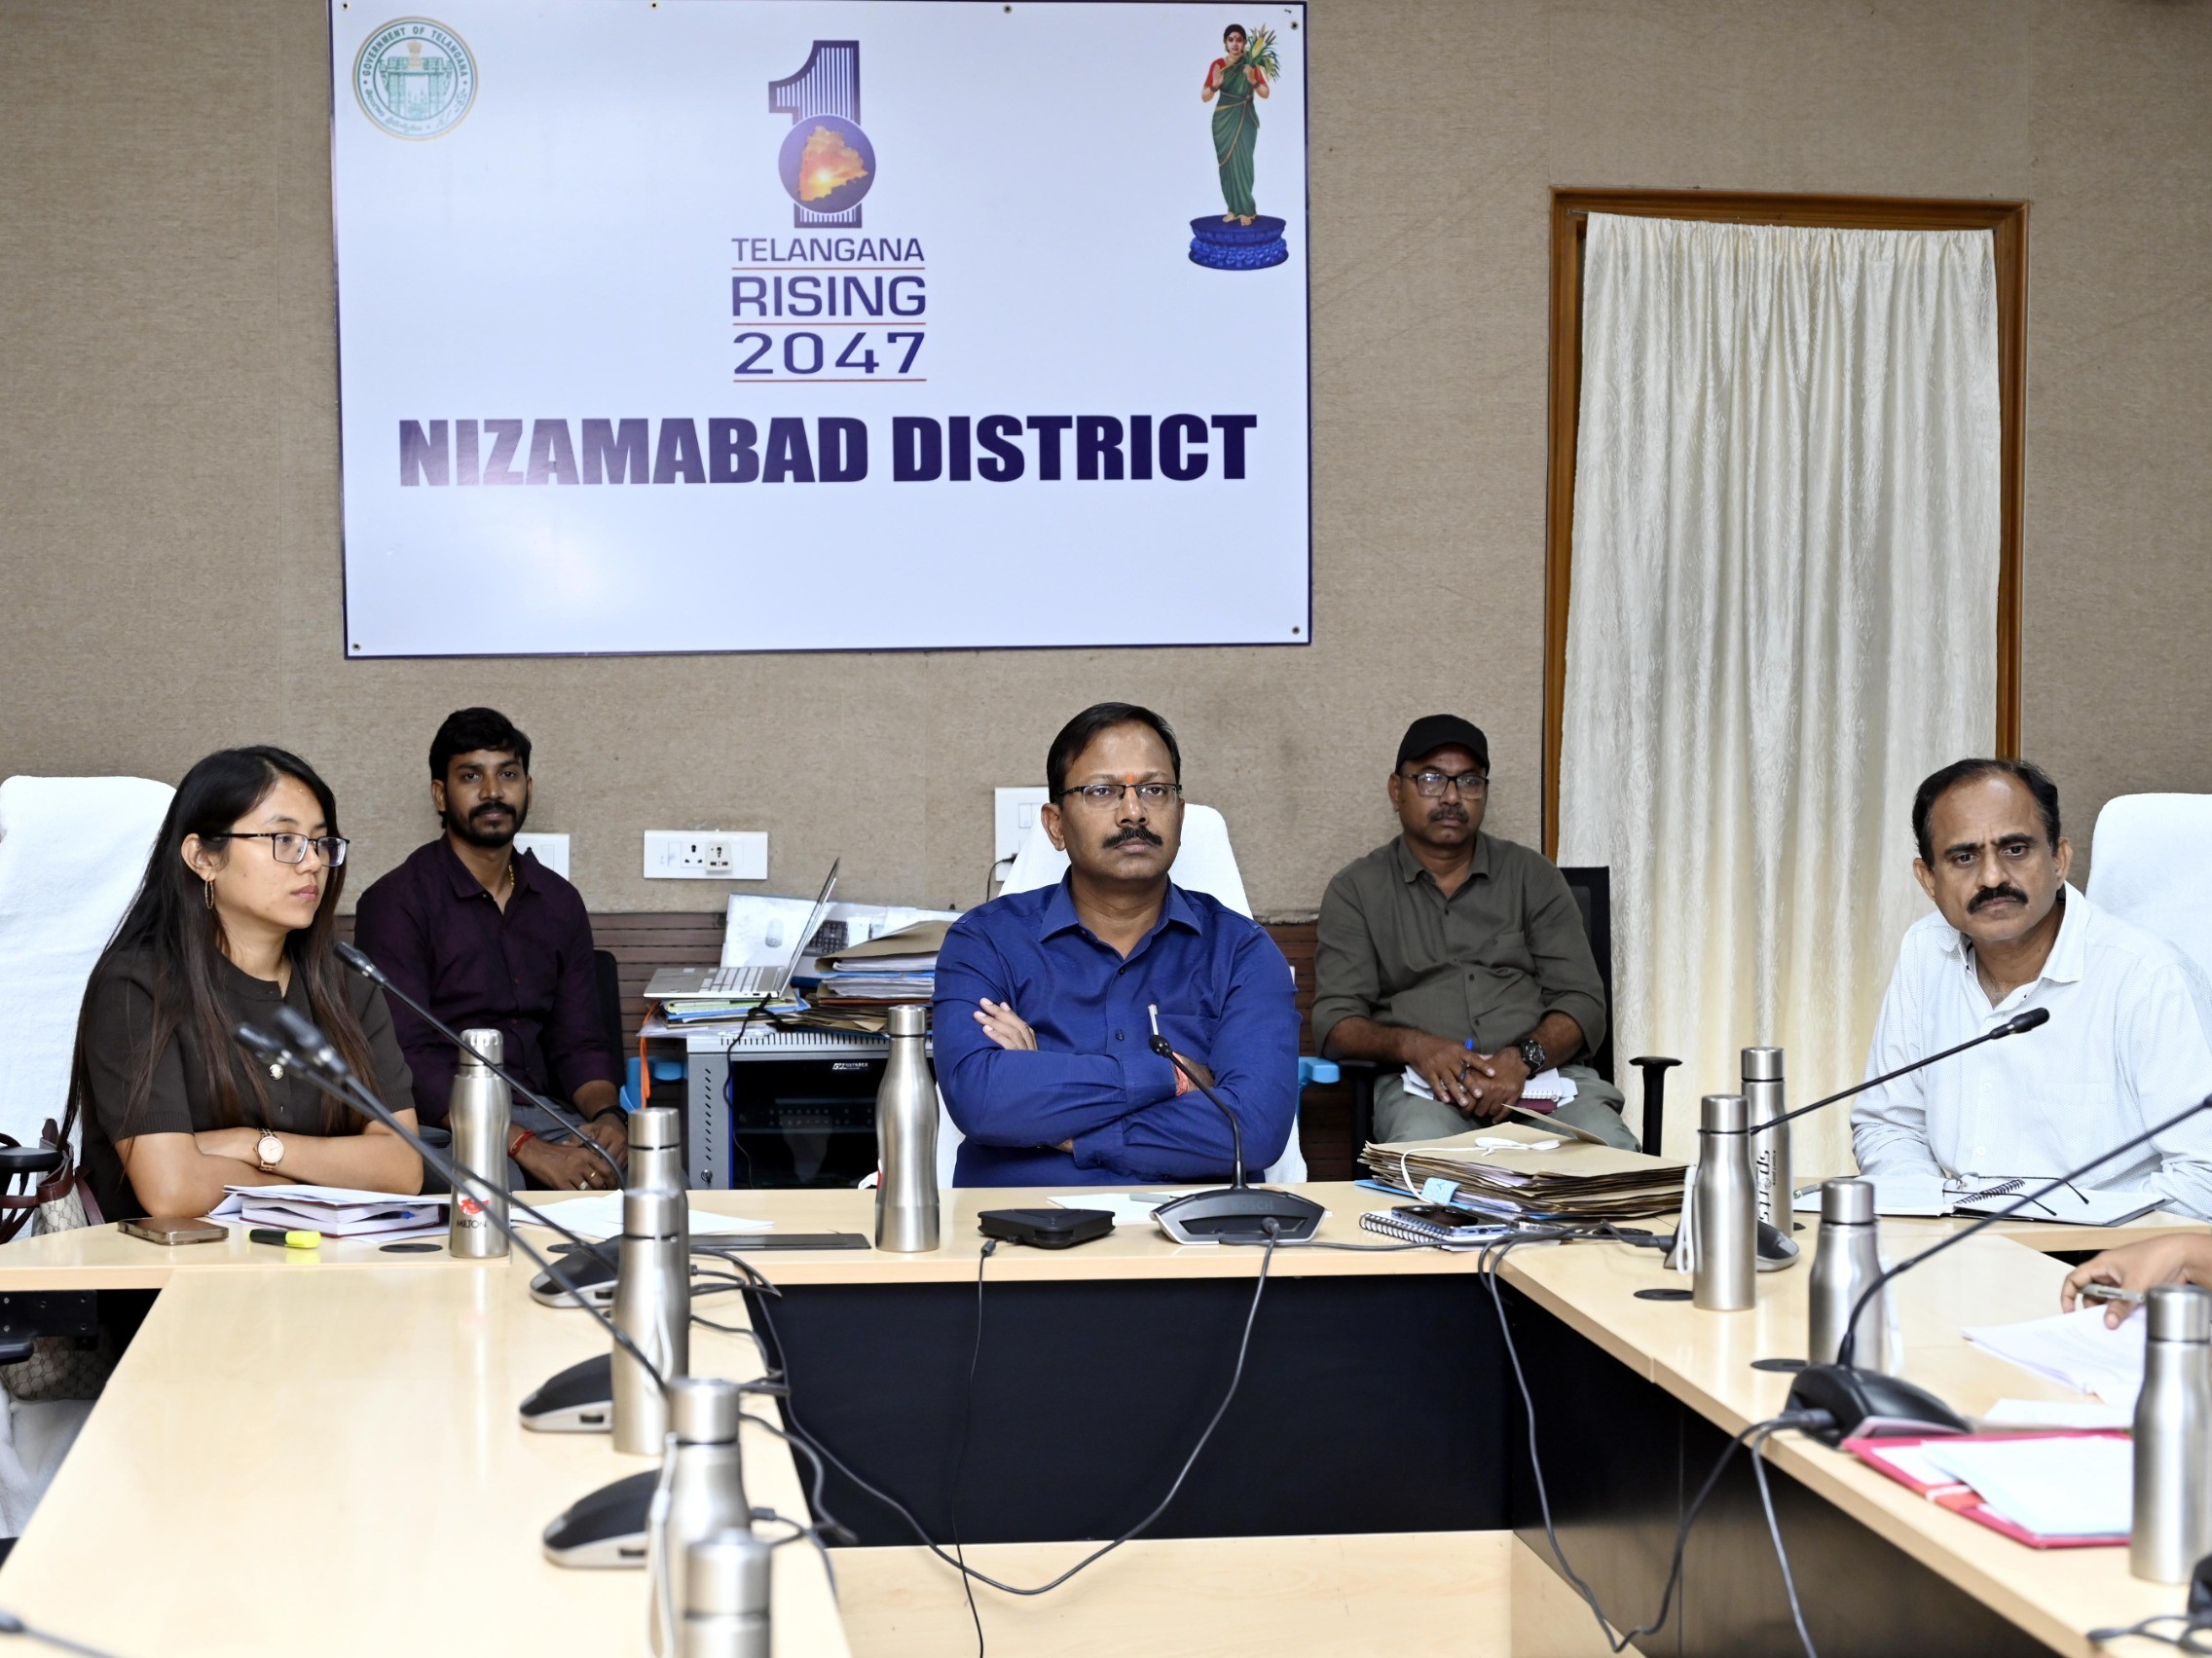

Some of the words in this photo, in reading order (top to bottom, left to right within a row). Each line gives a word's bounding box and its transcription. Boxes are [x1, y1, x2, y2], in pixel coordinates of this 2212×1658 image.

[362, 27, 406, 77] GOVERNMENT
[413, 26, 425, 35] OF
[431, 30, 469, 77] TELANGANA
[732, 238, 925, 262] TELANGANA
[732, 276, 926, 316] RISING
[733, 332, 925, 375] 2047
[399, 417, 868, 487] NIZAMABAD
[893, 413, 1257, 482] DISTRICT
[456, 1219, 487, 1229] MILTON
